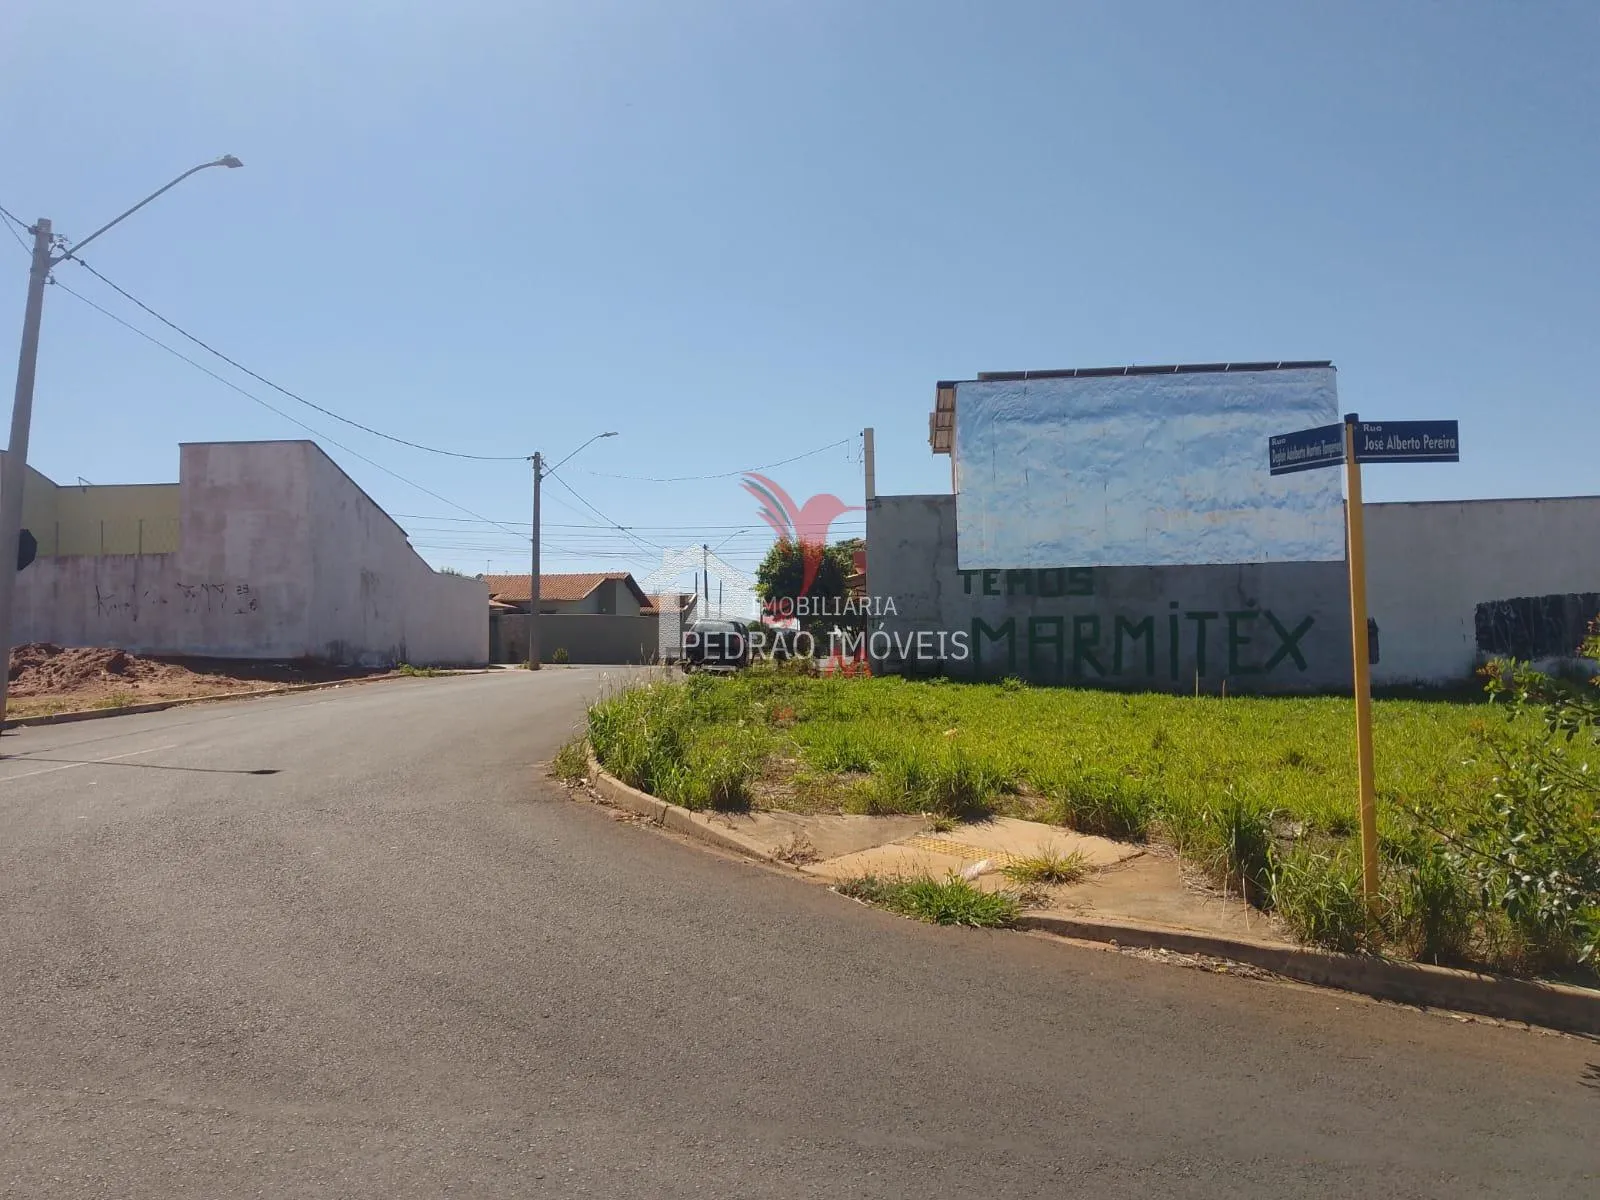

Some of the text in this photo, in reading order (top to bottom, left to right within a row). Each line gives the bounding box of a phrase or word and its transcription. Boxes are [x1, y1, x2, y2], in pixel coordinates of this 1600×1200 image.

[1363, 424, 1382, 432] Rua
[1271, 438, 1287, 446] Rua
[1364, 434, 1456, 451] José Alberto Pereira
[958, 569, 1094, 597] TEMOS
